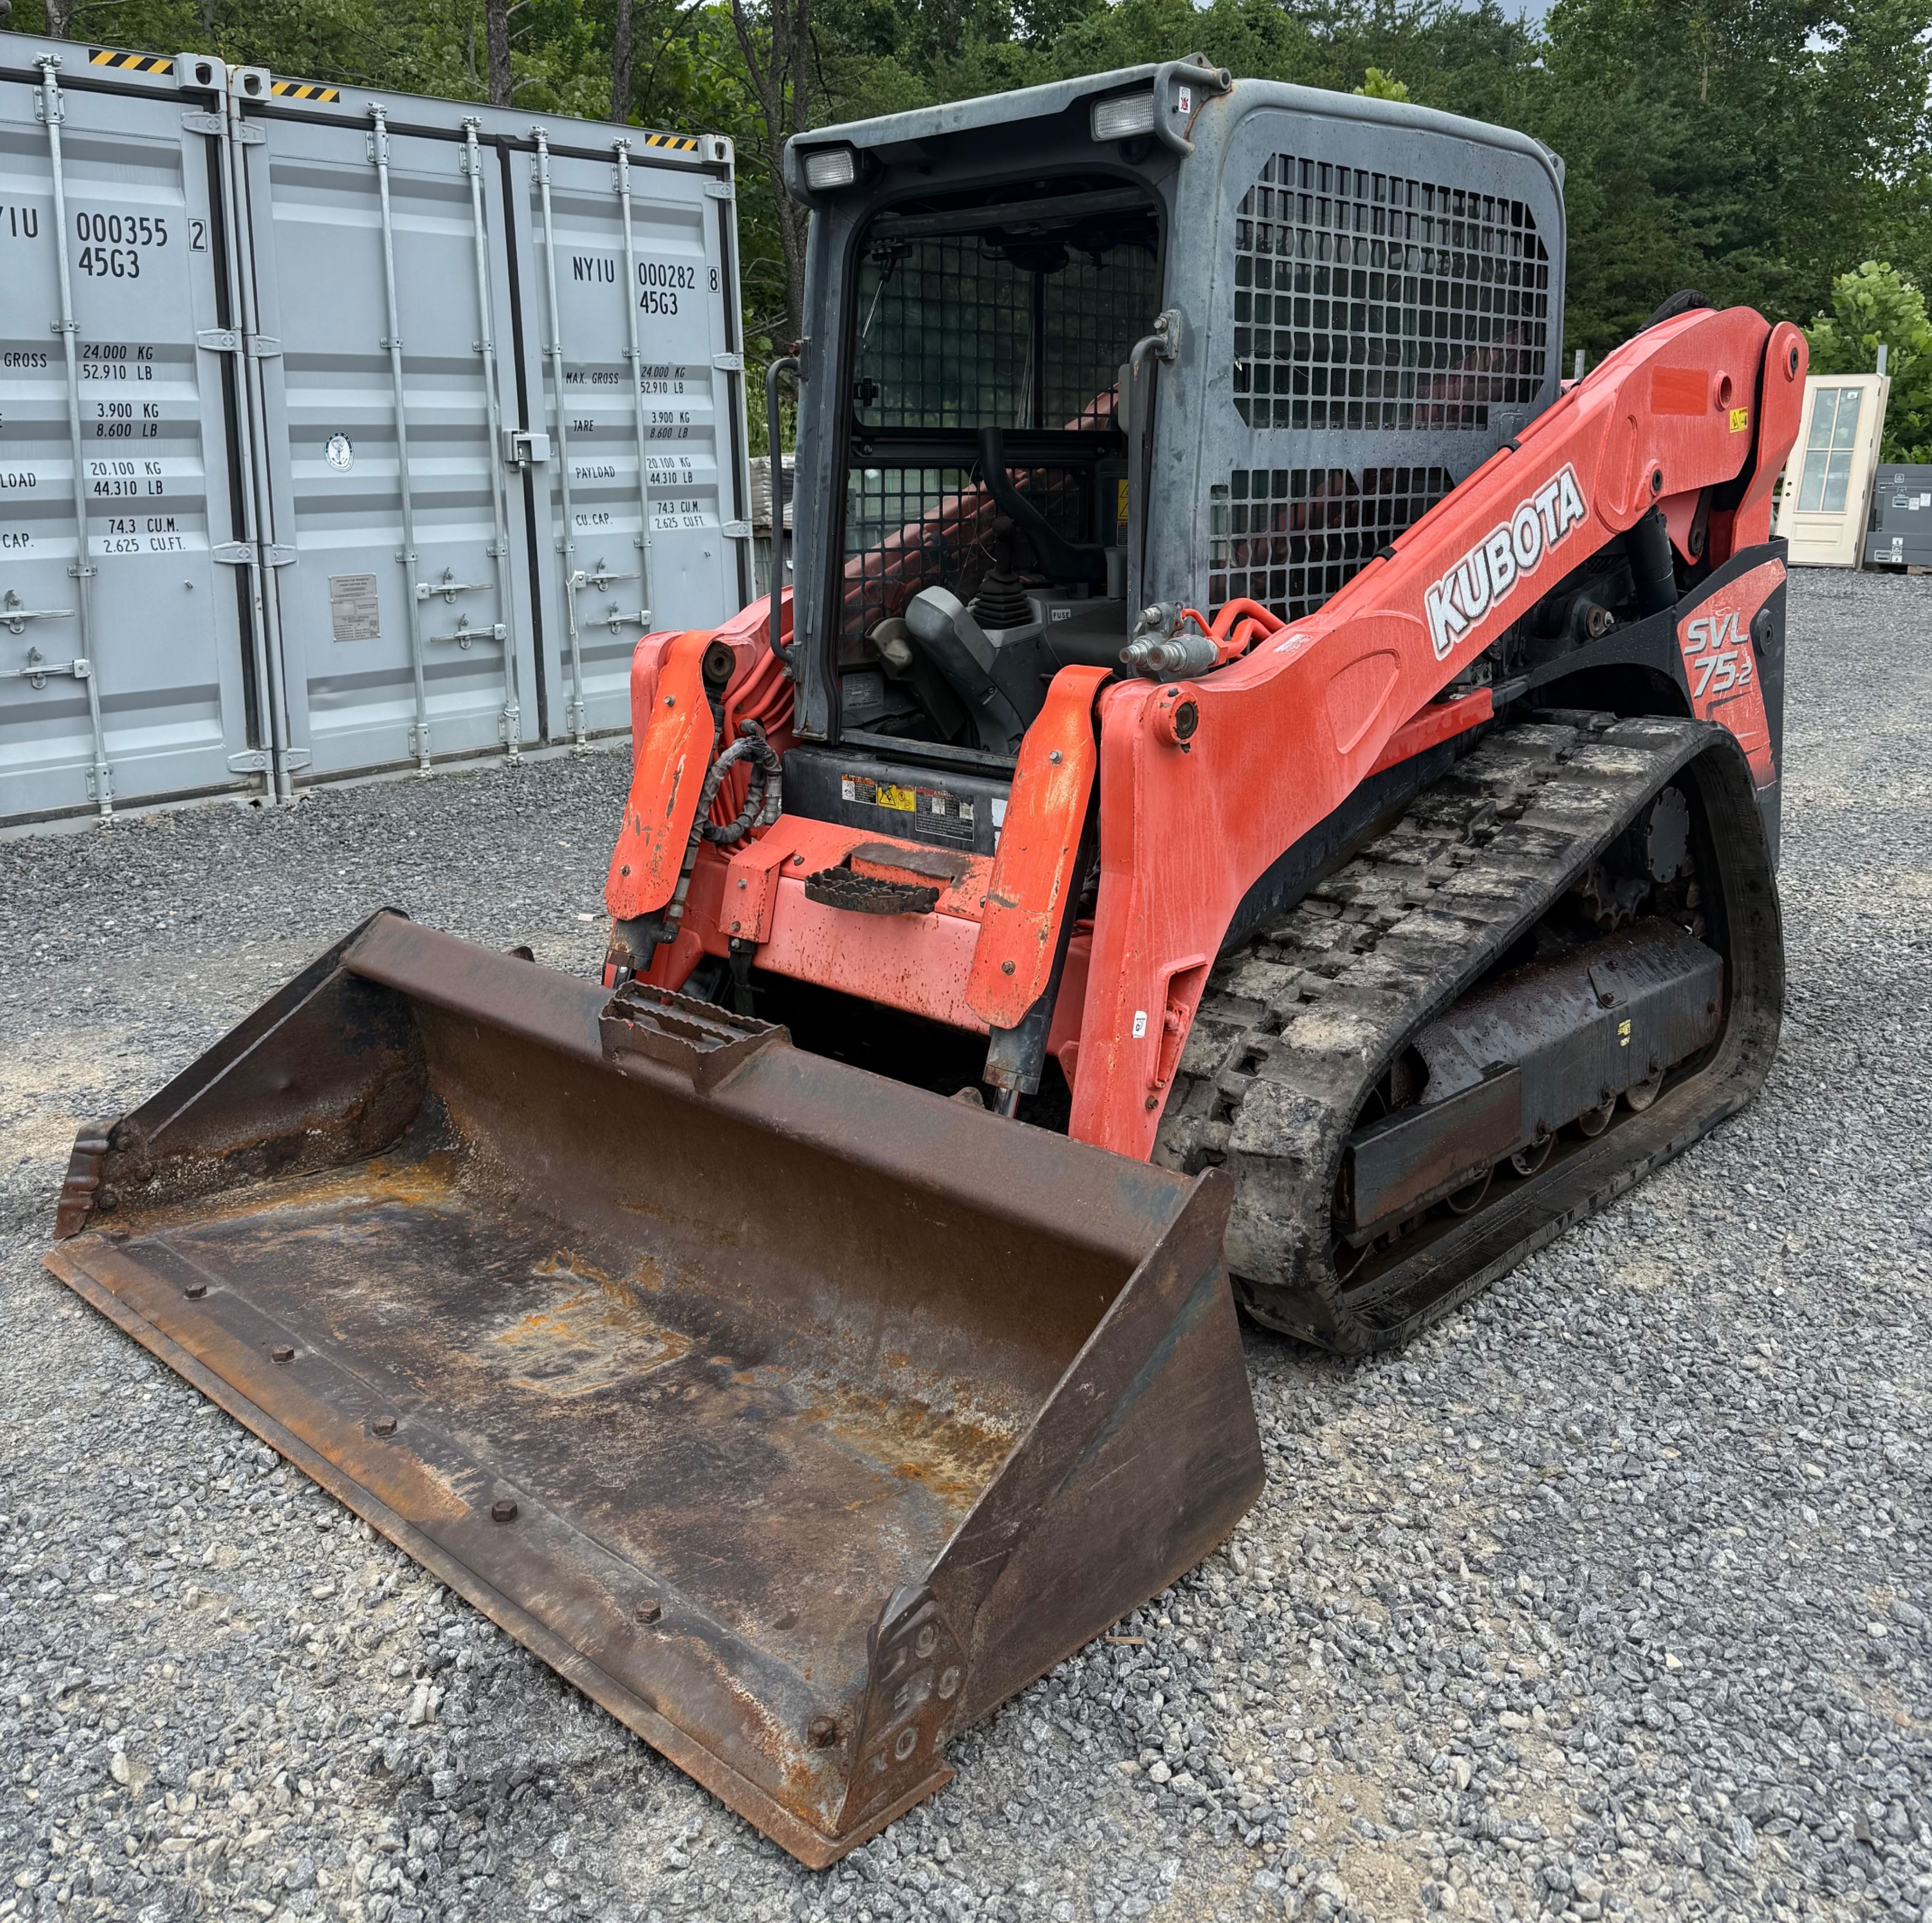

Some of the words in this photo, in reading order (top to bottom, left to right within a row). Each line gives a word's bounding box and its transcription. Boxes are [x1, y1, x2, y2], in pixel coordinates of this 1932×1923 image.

[0, 207, 39, 238] IU
[77, 212, 168, 246] 000355
[192, 222, 205, 249] 2
[79, 247, 140, 278] 45G3
[573, 256, 614, 283] NYIU
[639, 262, 695, 289] 000282
[710, 269, 718, 291] 8
[640, 291, 678, 315] 45G3
[4, 353, 47, 367] GROSS
[138, 346, 153, 360] KG
[138, 365, 152, 380] LB
[566, 372, 587, 384] MAX.
[592, 372, 619, 384] GROSS
[675, 367, 685, 378] KG
[674, 382, 683, 394] LB
[143, 403, 158, 418] KG
[680, 412, 690, 423] KG
[142, 423, 157, 437] LB
[573, 420, 594, 431] TARE
[678, 427, 688, 438] LB
[144, 462, 161, 475] KG
[679, 457, 691, 467] KG
[576, 466, 615, 479] PAYLOAD
[683, 471, 693, 483] LB
[148, 481, 163, 495] LB
[657, 502, 674, 514] 74.3
[109, 519, 136, 533] 74.3
[2, 533, 34, 548] CAP.
[1428, 469, 1585, 651] KUBOTA
[1684, 612, 1749, 655] SVL
